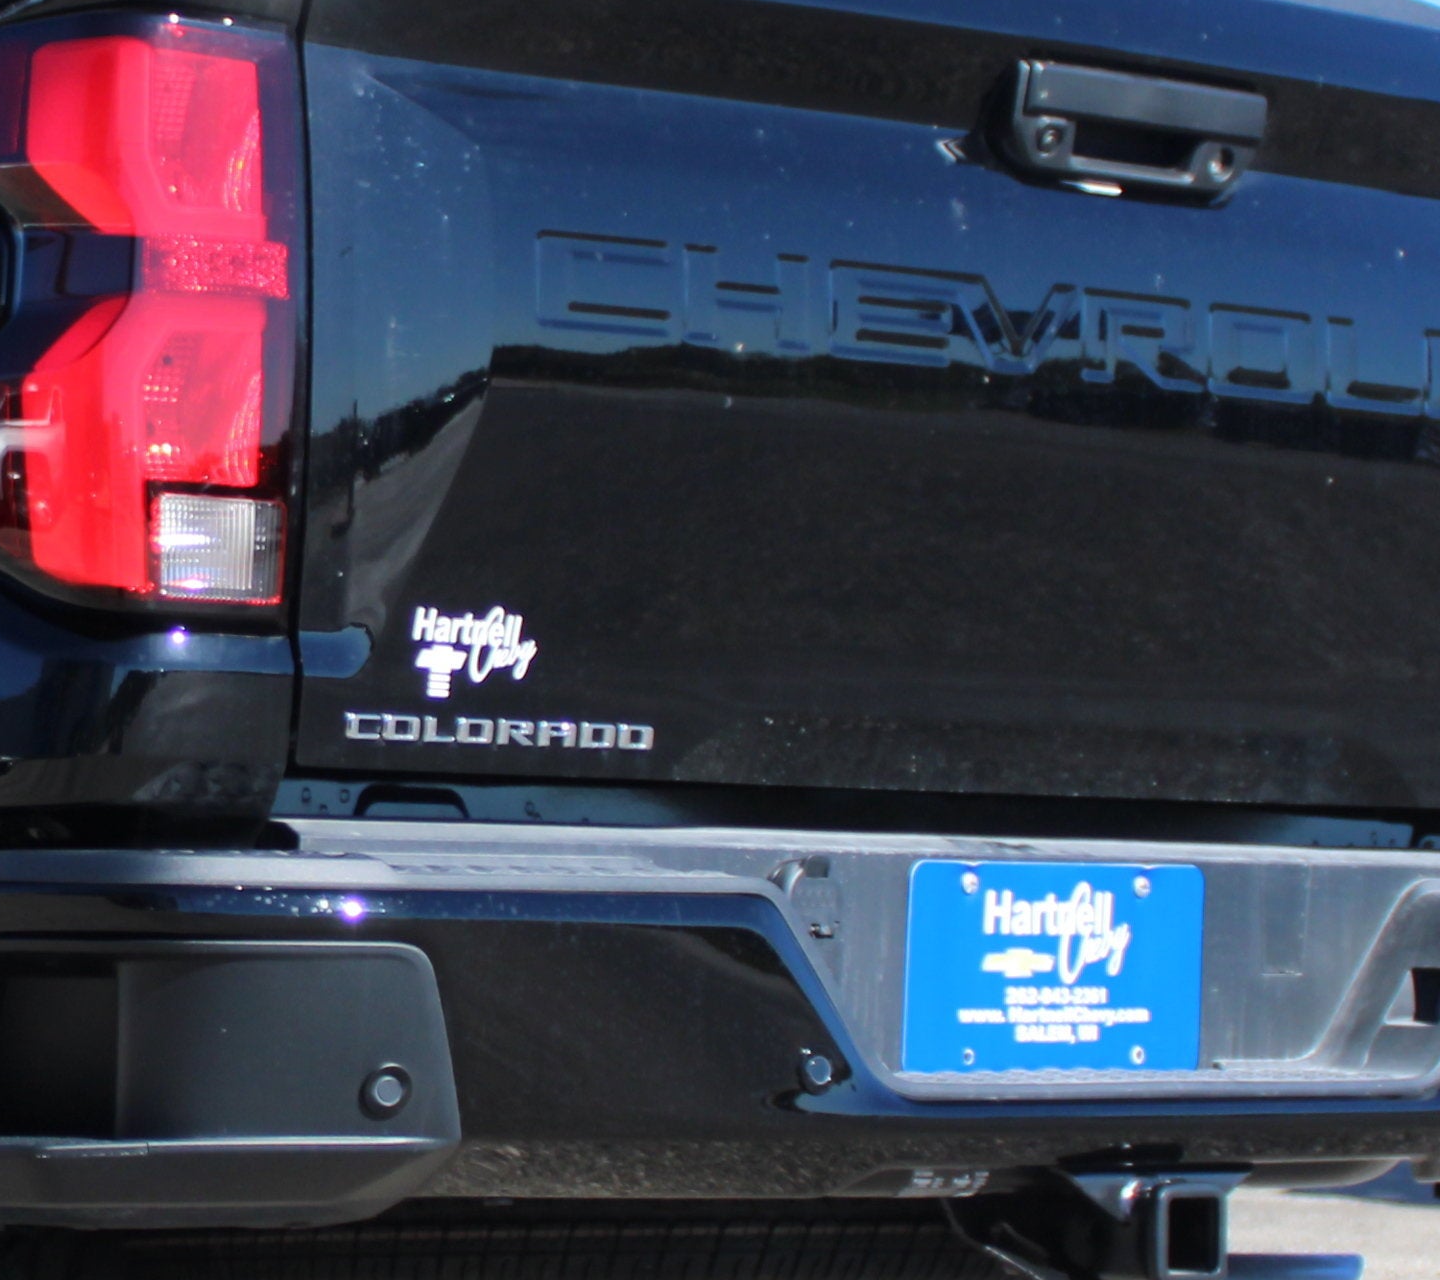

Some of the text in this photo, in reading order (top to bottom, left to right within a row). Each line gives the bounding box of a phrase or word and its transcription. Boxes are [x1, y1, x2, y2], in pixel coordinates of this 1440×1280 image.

[412, 606, 524, 648] Hartnell
[344, 711, 655, 751] COLORADO
[984, 889, 1113, 935] Hartnell
